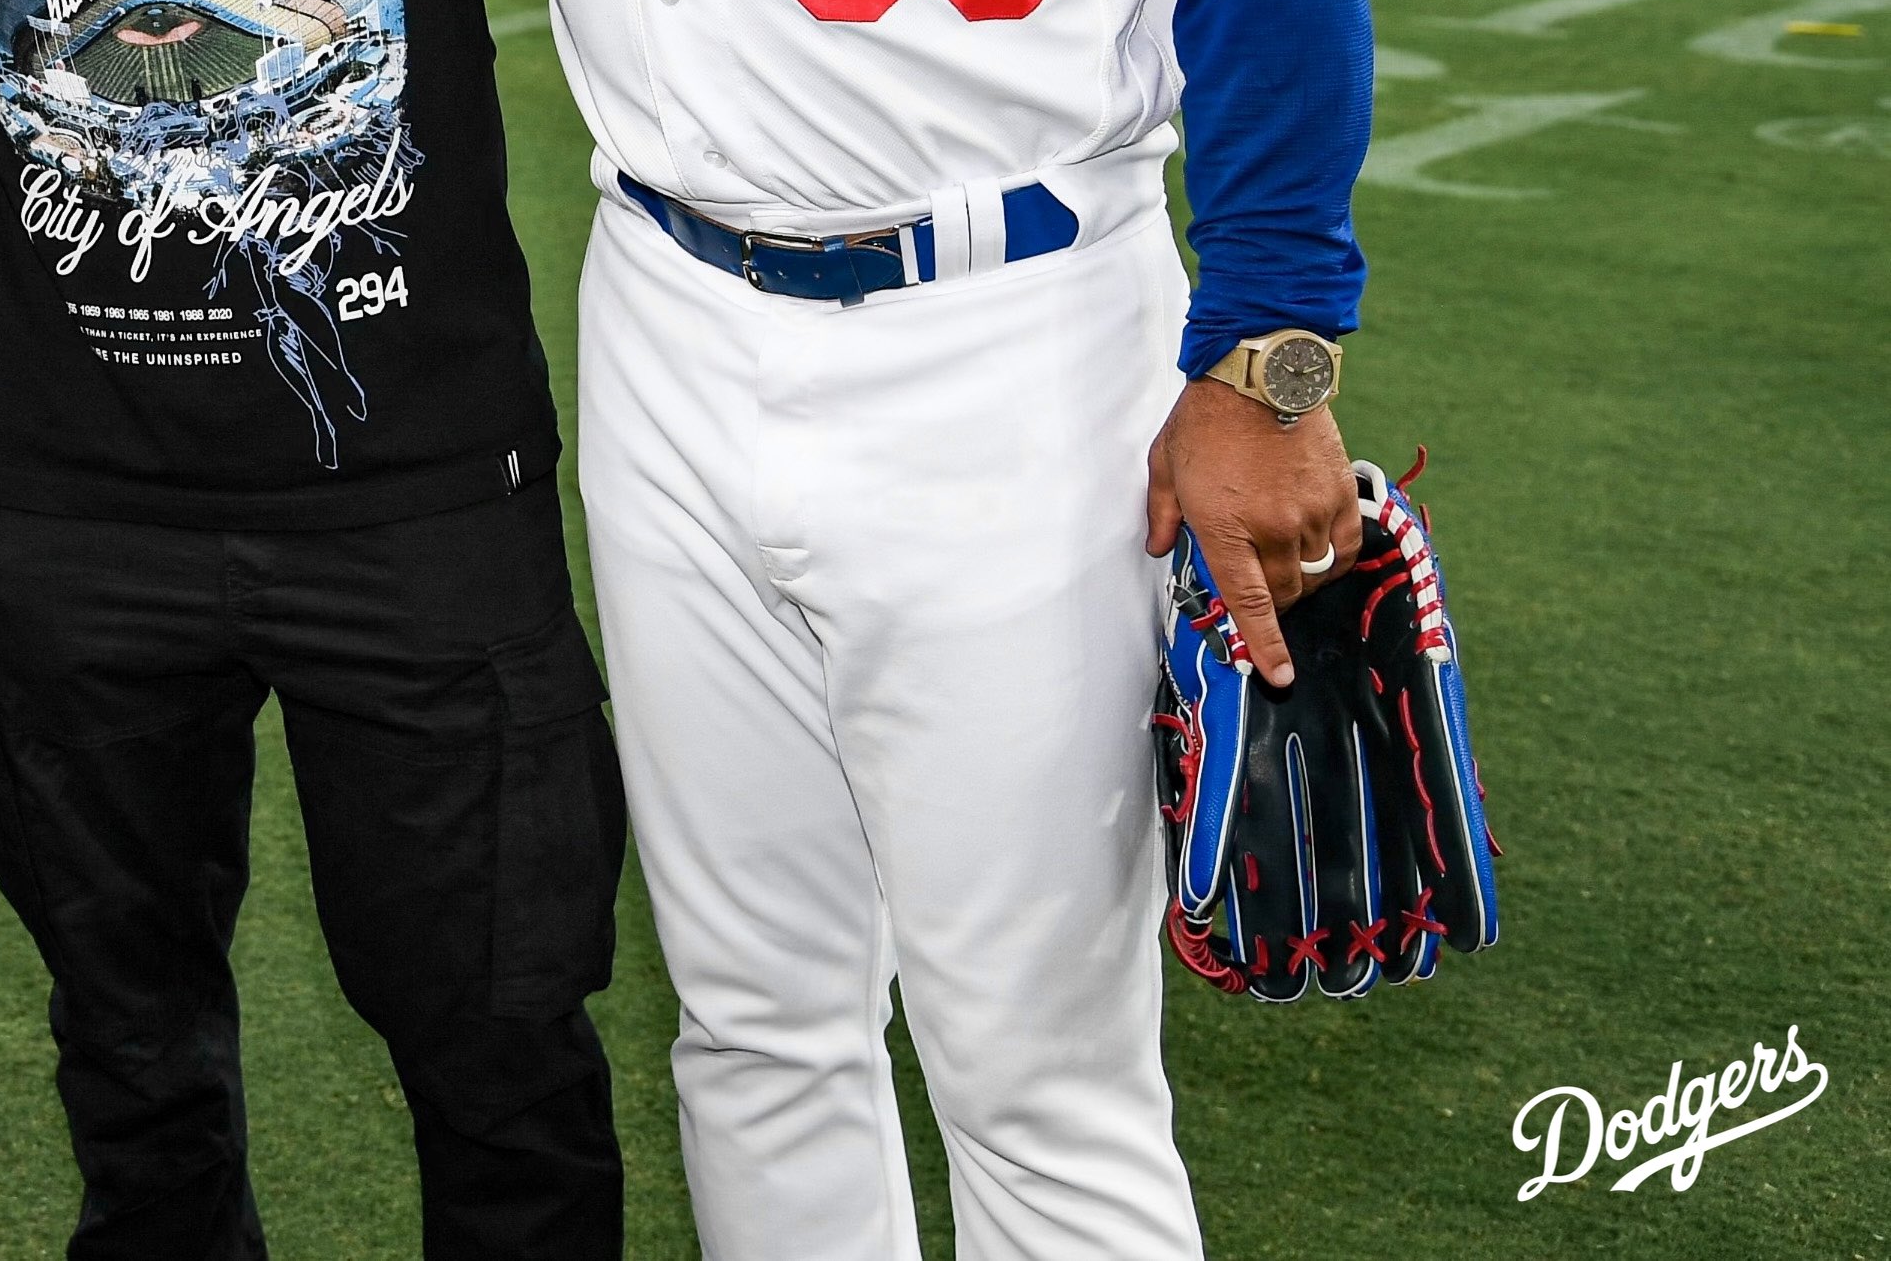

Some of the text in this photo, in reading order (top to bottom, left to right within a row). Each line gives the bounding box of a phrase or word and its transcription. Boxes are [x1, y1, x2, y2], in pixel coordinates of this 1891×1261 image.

[20, 129, 416, 282] City of Angels
[336, 267, 409, 321] 294
[104, 306, 126, 320] 1963
[128, 309, 150, 321] 1965
[152, 310, 175, 322] 1981
[208, 308, 233, 321] 2020
[85, 327, 107, 338] THAN
[109, 330, 115, 339] A
[118, 331, 154, 343] TICKET,
[157, 332, 176, 342] IT'S
[179, 333, 193, 342] AN
[196, 328, 263, 342] EXPERIENCE
[113, 351, 140, 365] THE
[146, 351, 243, 366] UNINSPIRED
